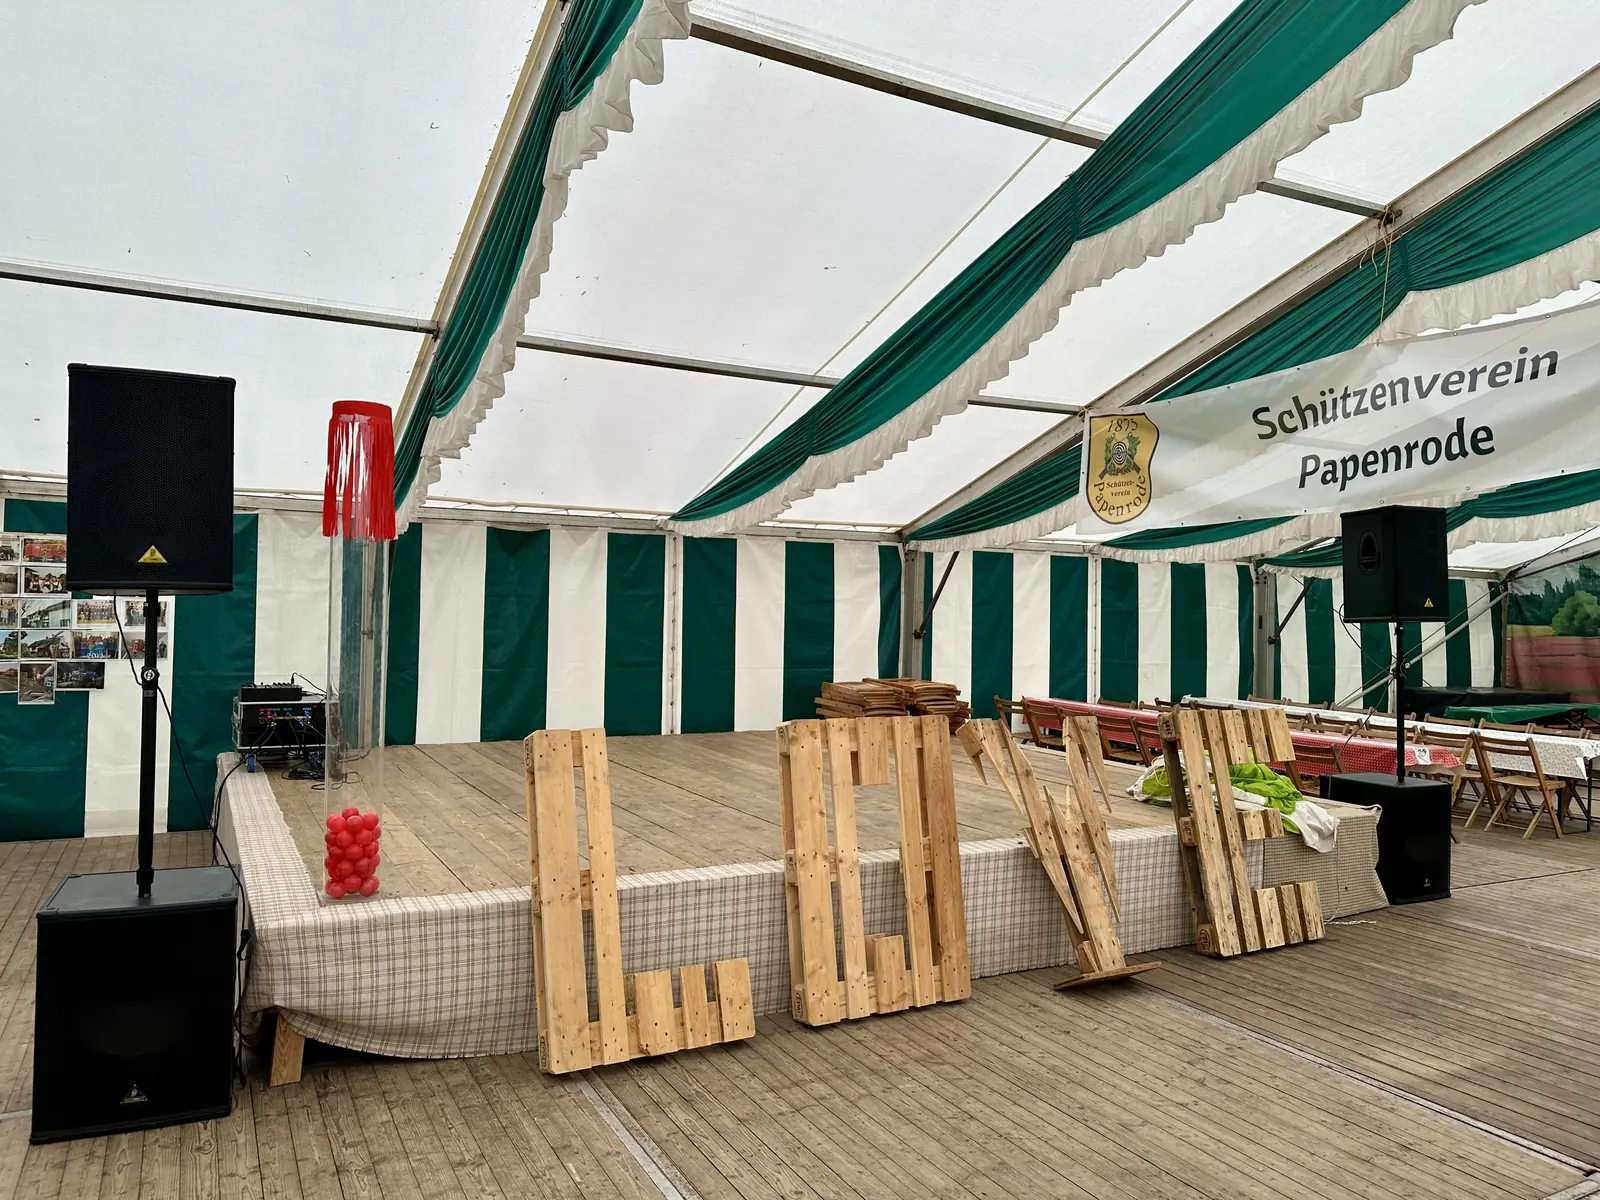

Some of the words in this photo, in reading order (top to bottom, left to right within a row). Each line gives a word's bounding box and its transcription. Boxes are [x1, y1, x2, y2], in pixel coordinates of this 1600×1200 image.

[1251, 345, 1559, 440] Schützenverein
[1107, 418, 1139, 433] 1875
[1298, 416, 1495, 492] Papenrode
[1094, 475, 1147, 517] Papenrode
[1106, 479, 1135, 489] Schützen-
[1110, 490, 1131, 498] verein
